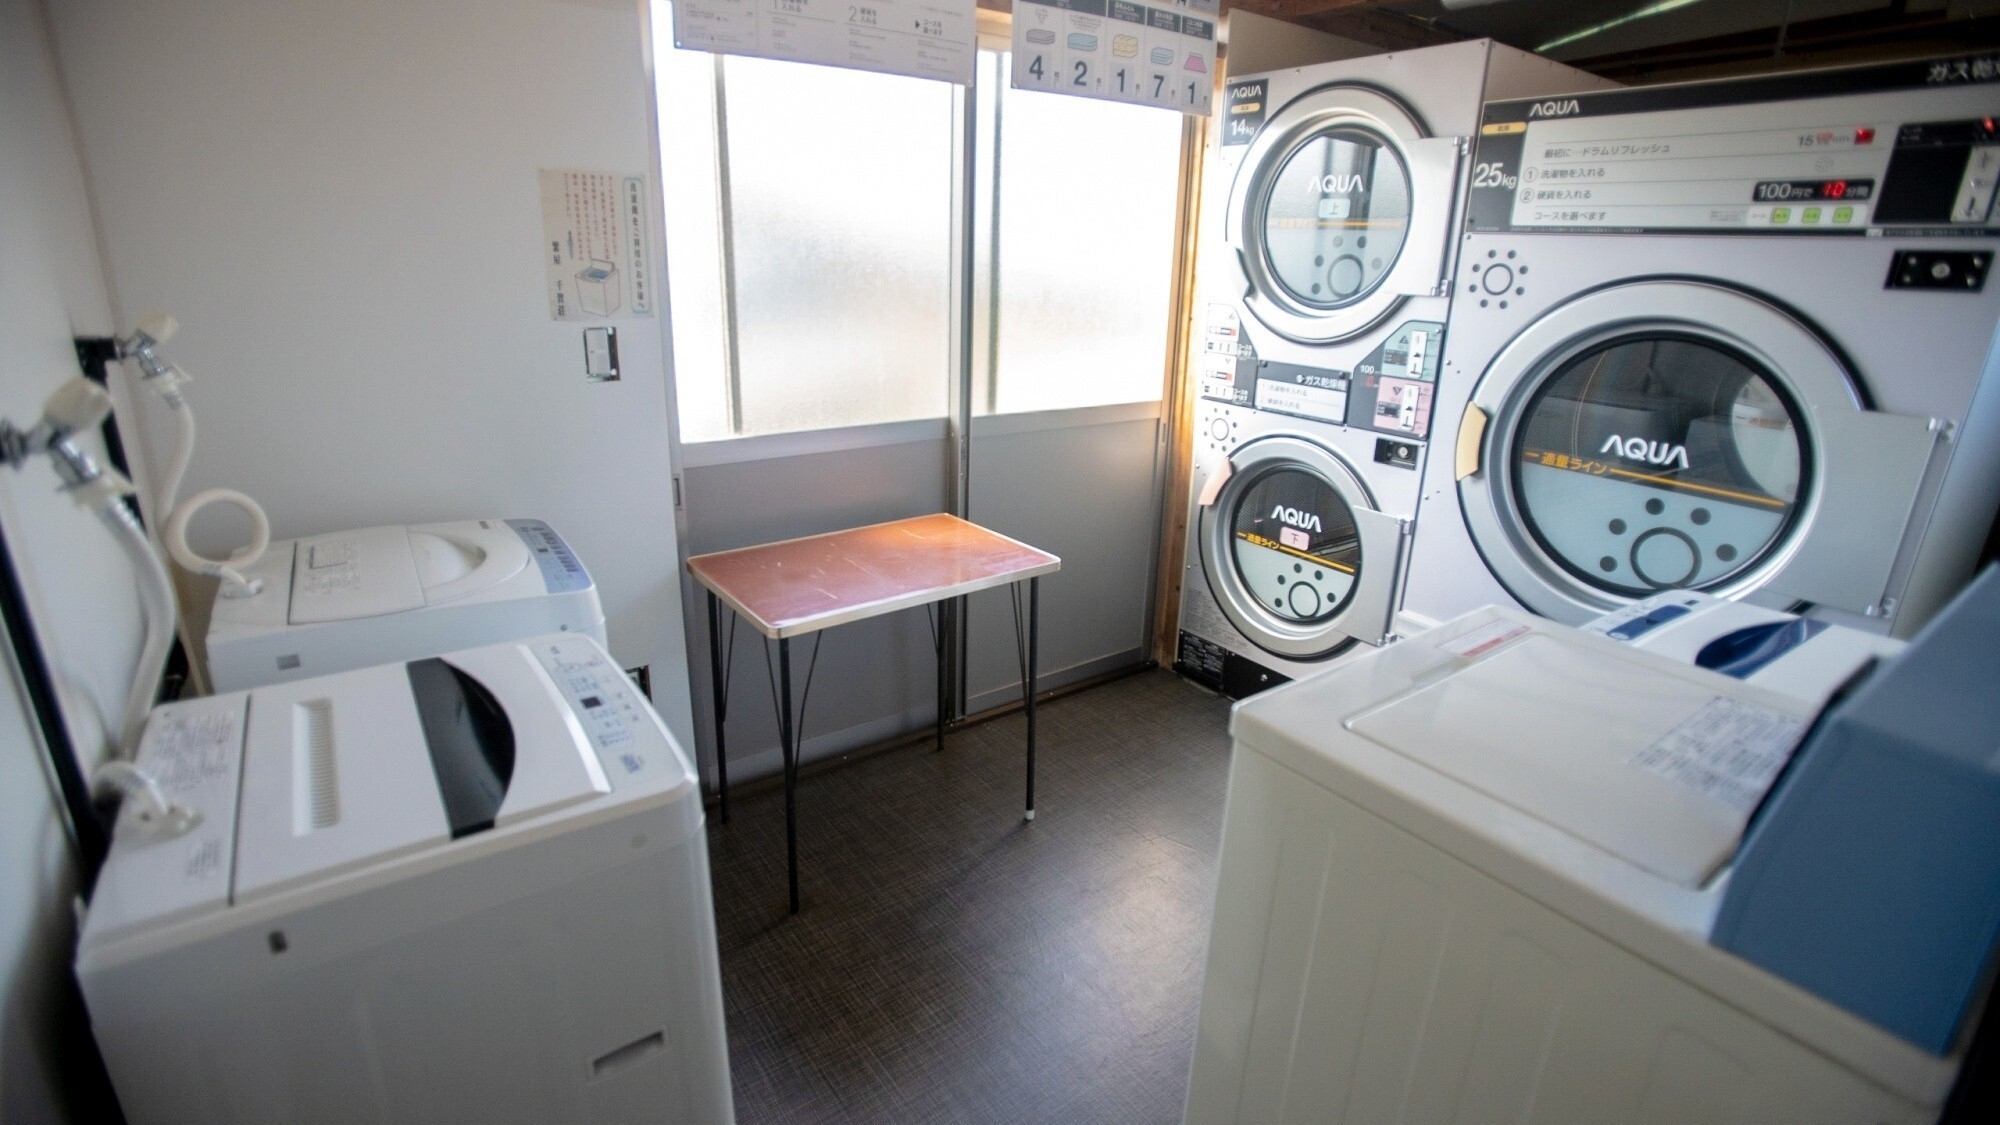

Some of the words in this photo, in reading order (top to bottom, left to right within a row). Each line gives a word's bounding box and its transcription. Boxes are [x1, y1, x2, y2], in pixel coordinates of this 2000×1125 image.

[848, 5, 857, 21] 2
[1927, 56, 2000, 84] ガス乾
[1029, 54, 1044, 81] 4
[1073, 60, 1088, 86] 2
[1117, 68, 1126, 93] 1
[1153, 74, 1165, 98] 7
[1188, 81, 1196, 104] 1
[1231, 84, 1263, 99] AQUA
[1529, 99, 1580, 118] AQUA
[1231, 118, 1255, 136] 14kg
[1474, 162, 1517, 190] 25kg
[1541, 167, 1606, 179] 洗濯物を入れる
[1308, 174, 1364, 194] AQUA
[1537, 190, 1592, 200] 硬貨を入れる
[1328, 201, 1339, 215] 上
[1534, 211, 1607, 221] コースを選べます
[1360, 364, 1375, 375] 100
[1305, 376, 1347, 392] ガス乾燥機
[1600, 434, 1690, 469] AQUA
[1540, 450, 1607, 475] 適量ライン
[1271, 505, 1322, 533] AQUA
[1290, 533, 1300, 545] 下
